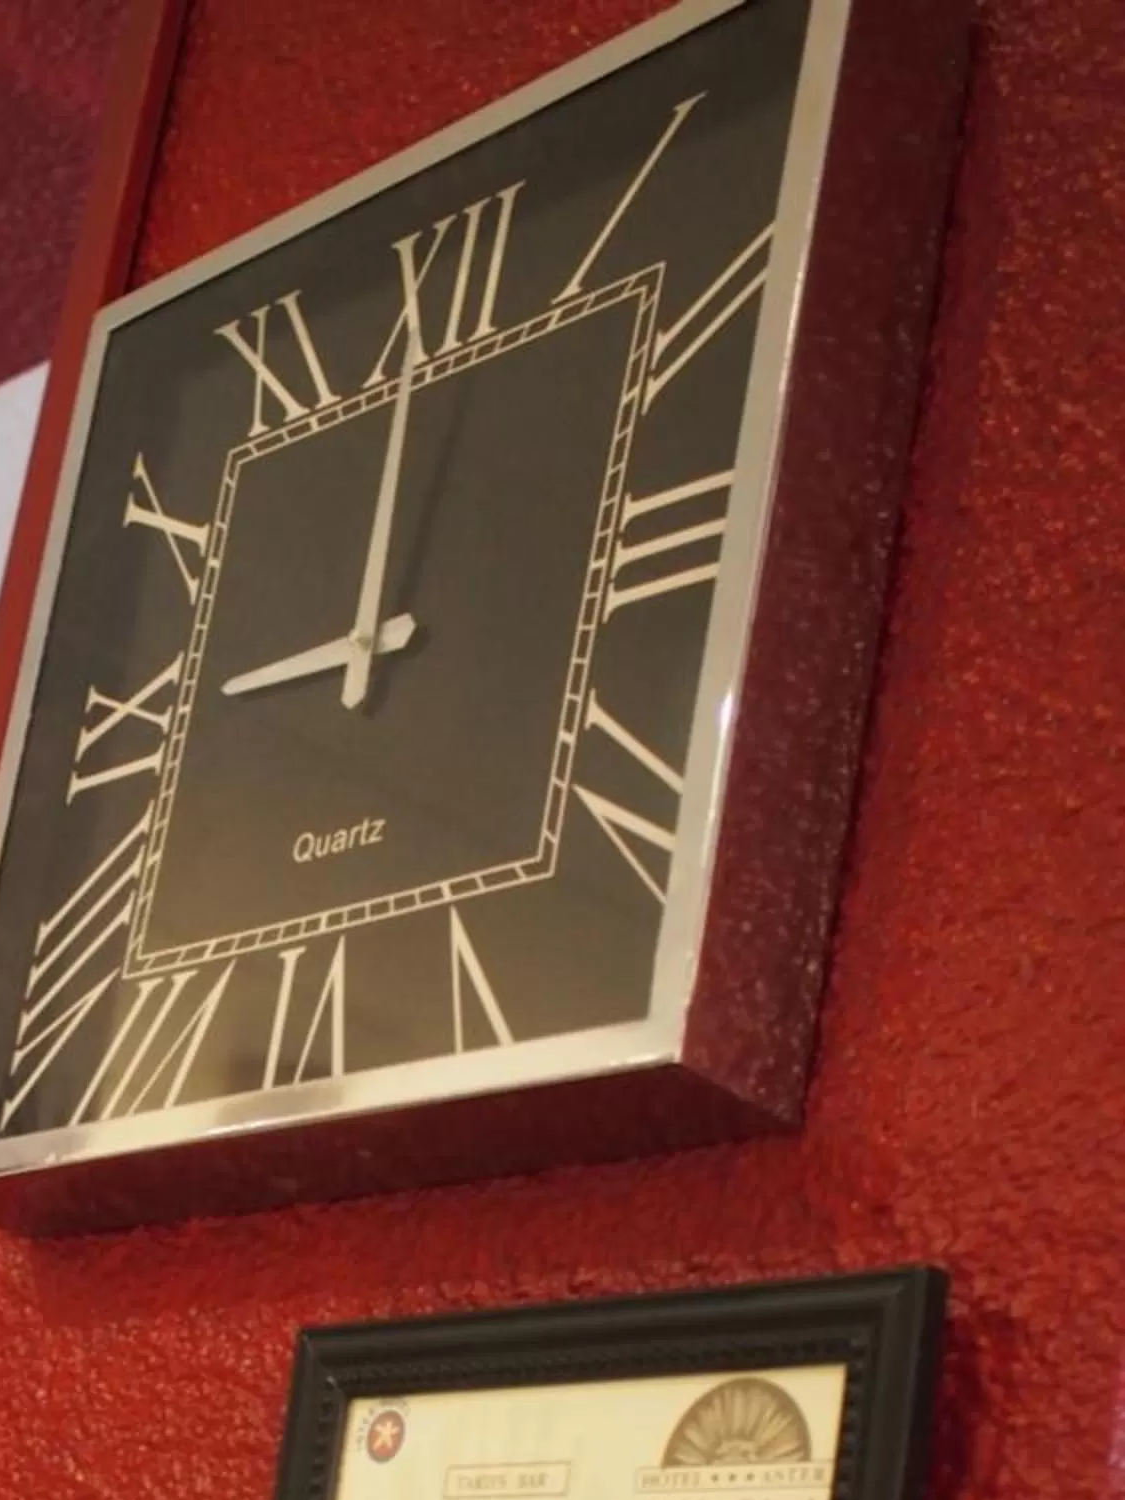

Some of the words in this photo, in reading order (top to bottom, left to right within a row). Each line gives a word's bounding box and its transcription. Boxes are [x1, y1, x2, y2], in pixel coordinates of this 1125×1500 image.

[362, 179, 526, 388] XII
[214, 288, 342, 437] XI
[122, 451, 212, 606] X
[602, 469, 736, 622] III
[66, 652, 186, 806] IX
[292, 815, 387, 865] Quartz
